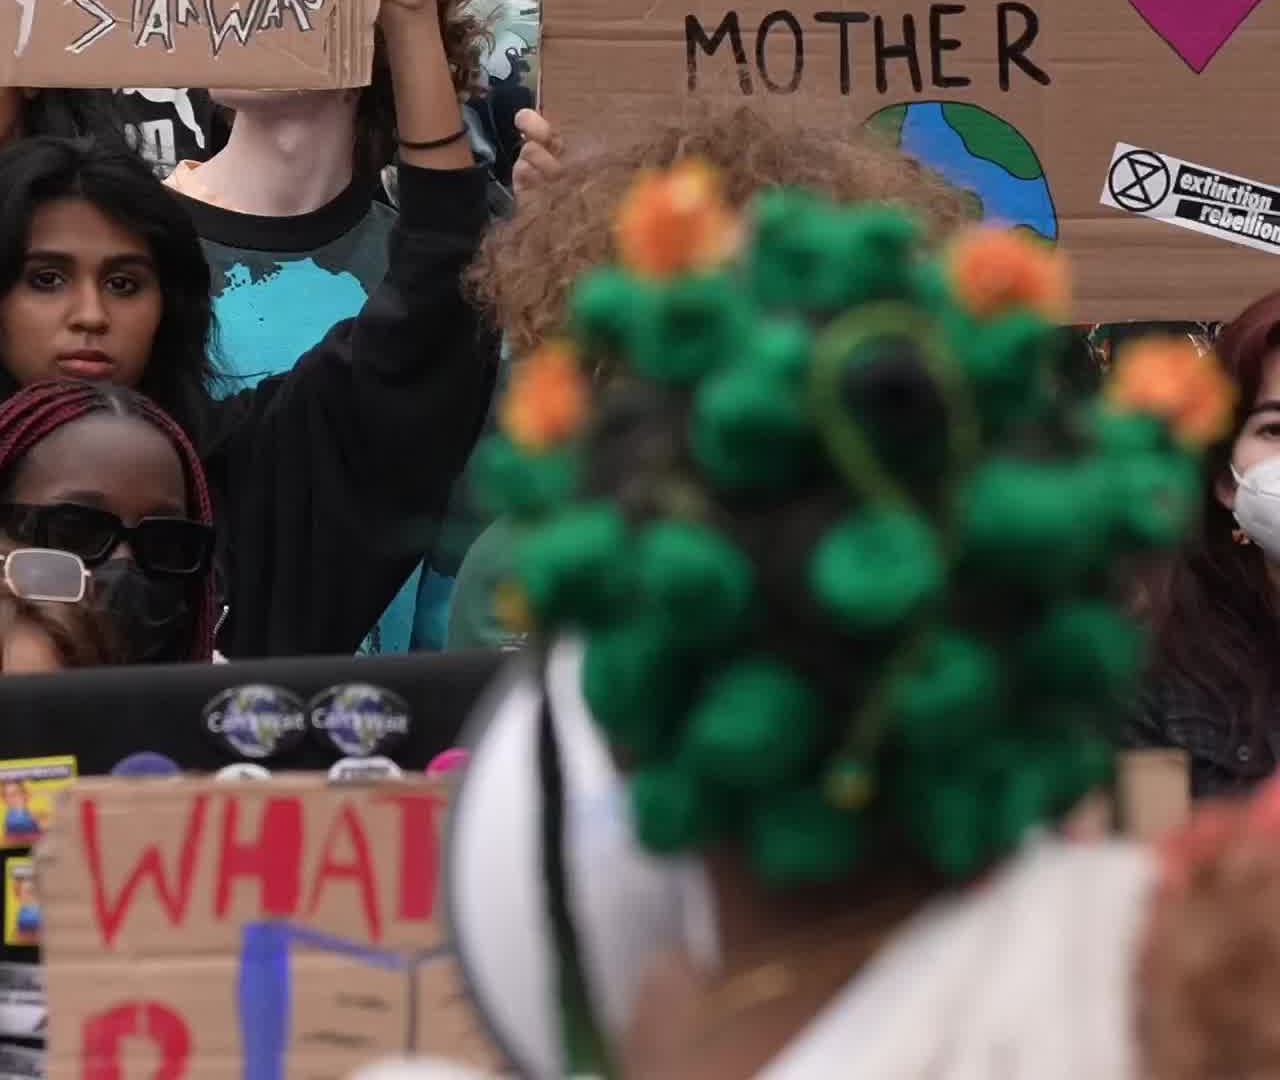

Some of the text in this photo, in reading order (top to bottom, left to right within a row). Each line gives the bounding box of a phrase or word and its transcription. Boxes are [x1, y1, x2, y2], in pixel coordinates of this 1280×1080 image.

[684, 1, 1051, 97] MOTHER
[1180, 170, 1274, 211] extinction
[80, 793, 447, 948] WHAT
